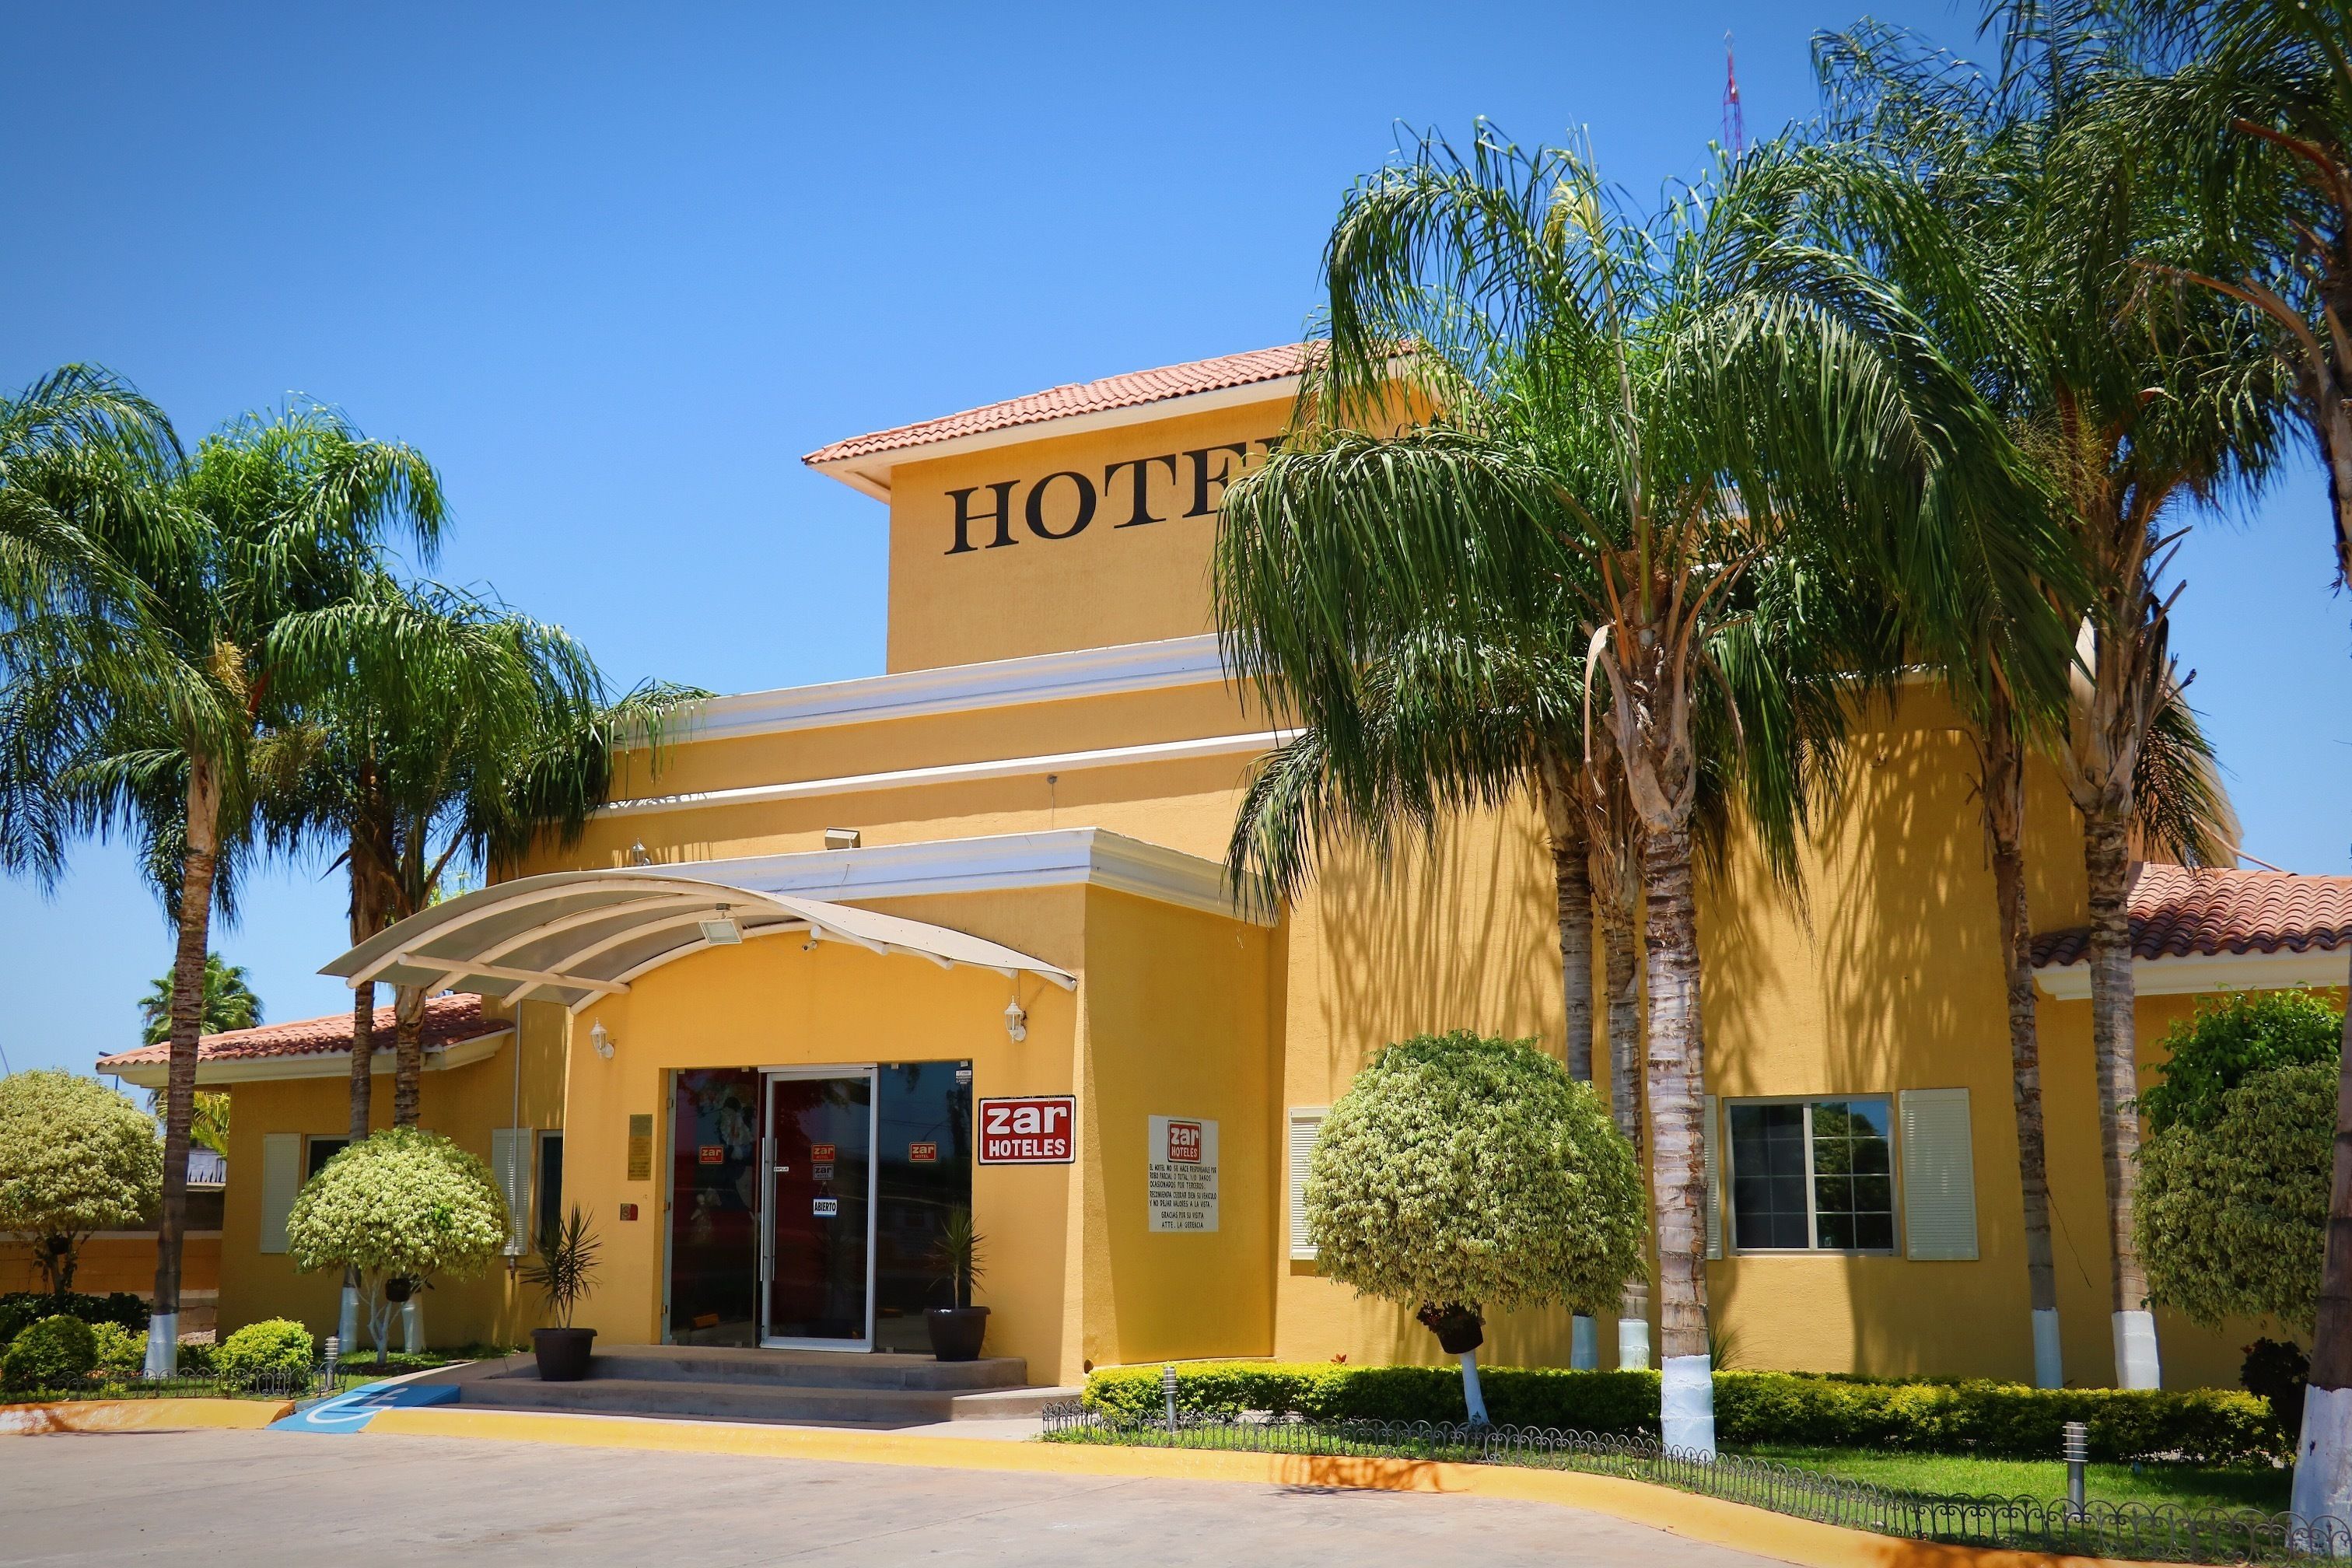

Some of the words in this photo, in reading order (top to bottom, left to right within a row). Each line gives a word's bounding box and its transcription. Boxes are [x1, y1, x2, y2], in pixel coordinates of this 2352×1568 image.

[944, 434, 1289, 555] HOTE
[987, 1106, 1067, 1134] zar
[1171, 1127, 1199, 1146] zar
[989, 1138, 1066, 1157] HOTELES
[1171, 1146, 1198, 1157] HOTELES
[814, 1202, 835, 1211] ABIERTO
